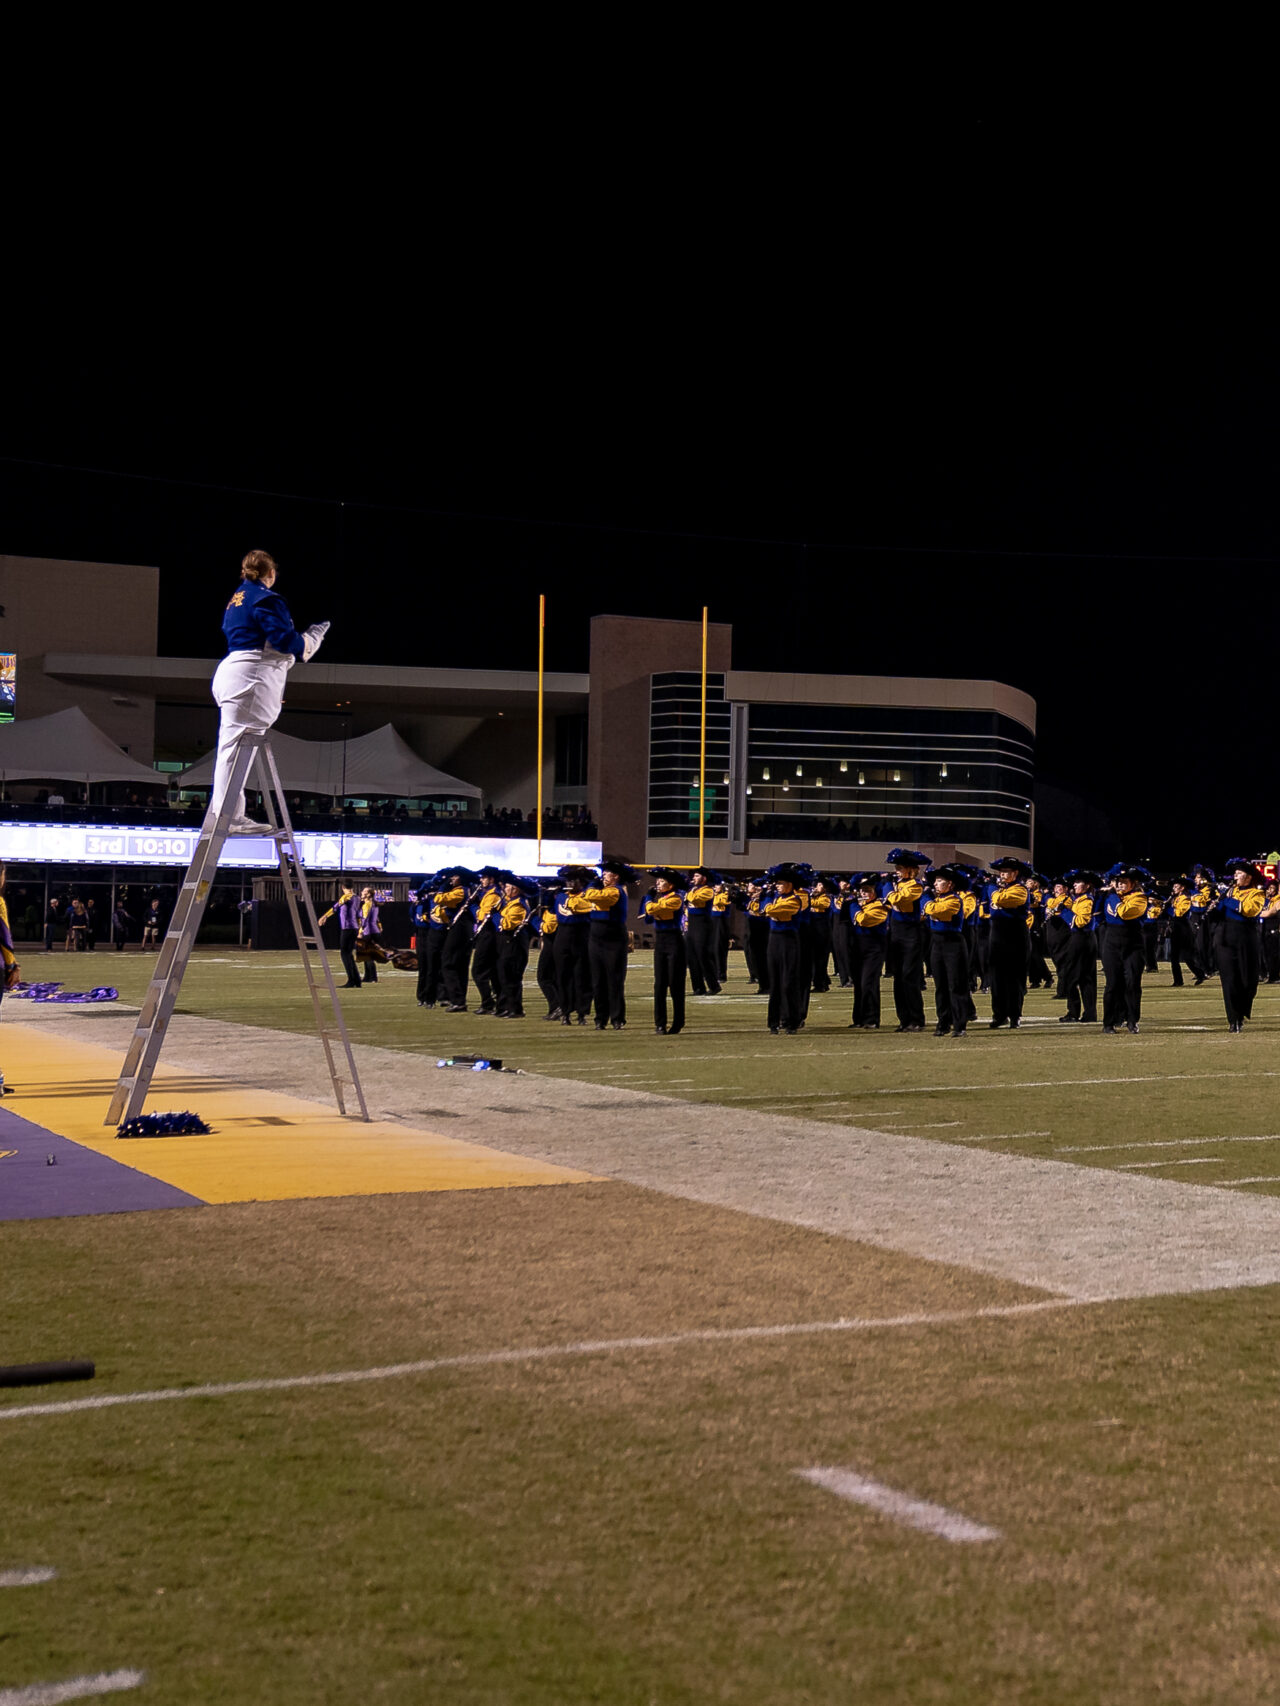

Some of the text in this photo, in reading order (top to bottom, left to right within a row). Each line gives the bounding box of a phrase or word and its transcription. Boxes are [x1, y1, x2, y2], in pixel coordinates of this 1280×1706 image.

[87, 837, 123, 853] 3rd
[134, 838, 186, 856] 10:10
[353, 841, 379, 859] 17
